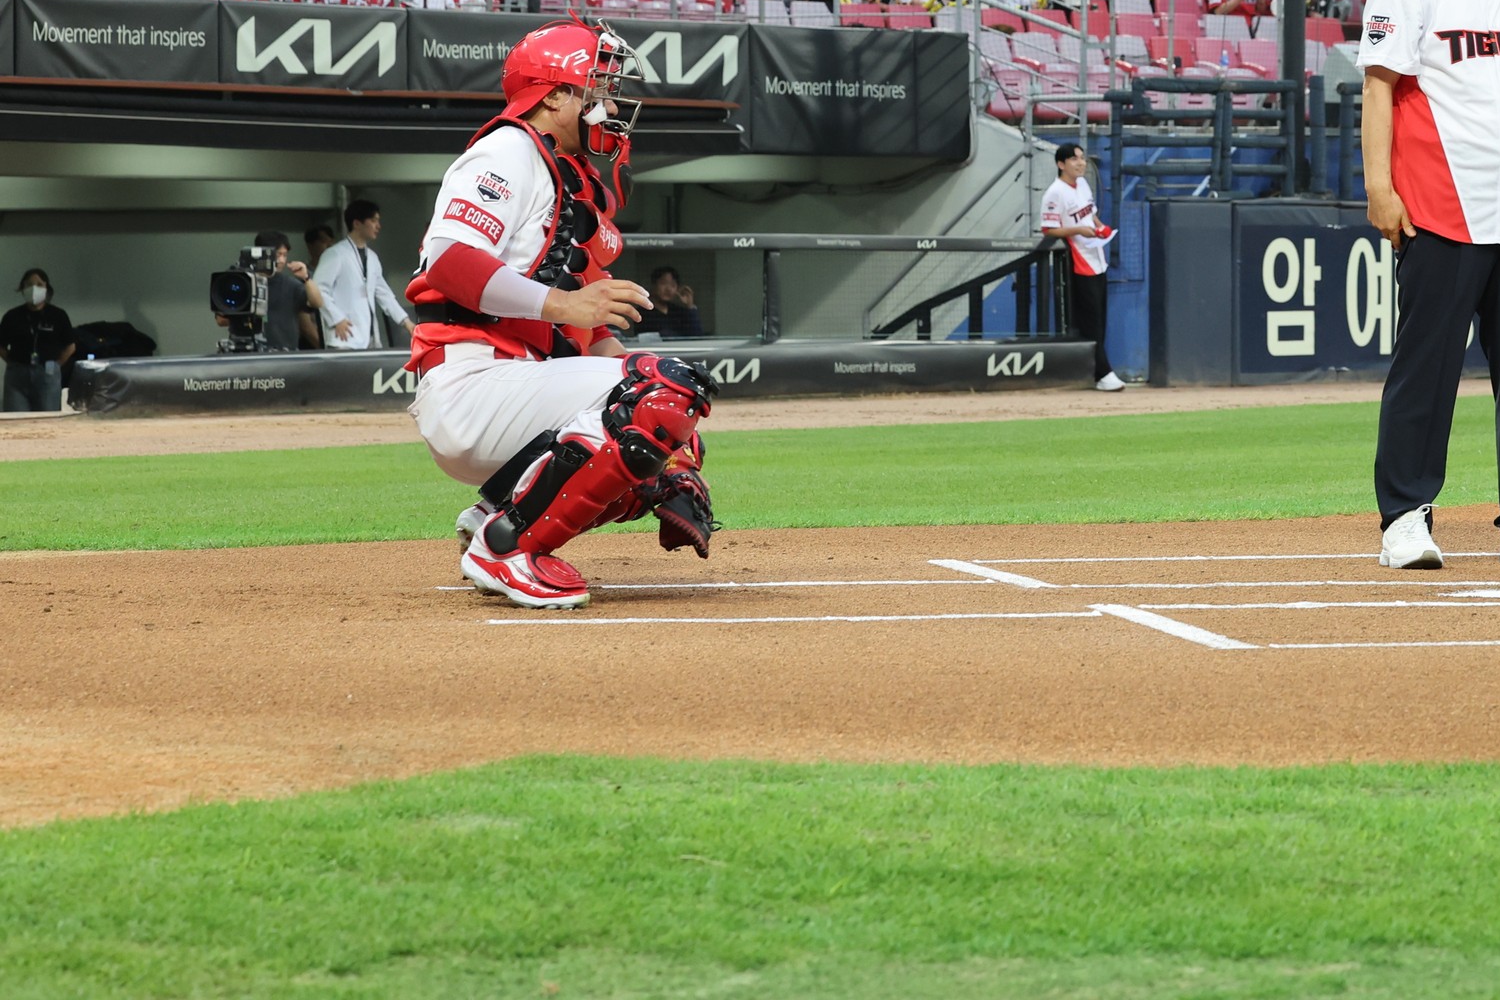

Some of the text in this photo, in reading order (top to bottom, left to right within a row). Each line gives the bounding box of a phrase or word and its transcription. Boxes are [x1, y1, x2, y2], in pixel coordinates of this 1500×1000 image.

[33, 21, 206, 51] Movement that inspires
[1365, 20, 1396, 34] TIGERS
[236, 16, 397, 77] KIA
[423, 38, 494, 60] Movement
[765, 75, 906, 100] Movement that inspires
[476, 174, 513, 201] TIGERS
[464, 206, 503, 241] COFFEE
[734, 238, 755, 247] KIA
[917, 240, 937, 249] KIA
[1262, 237, 1322, 357] 암
[834, 361, 916, 375] Movement that inspires
[986, 352, 1045, 377] KIA
[184, 376, 286, 392] Movement that inspires
